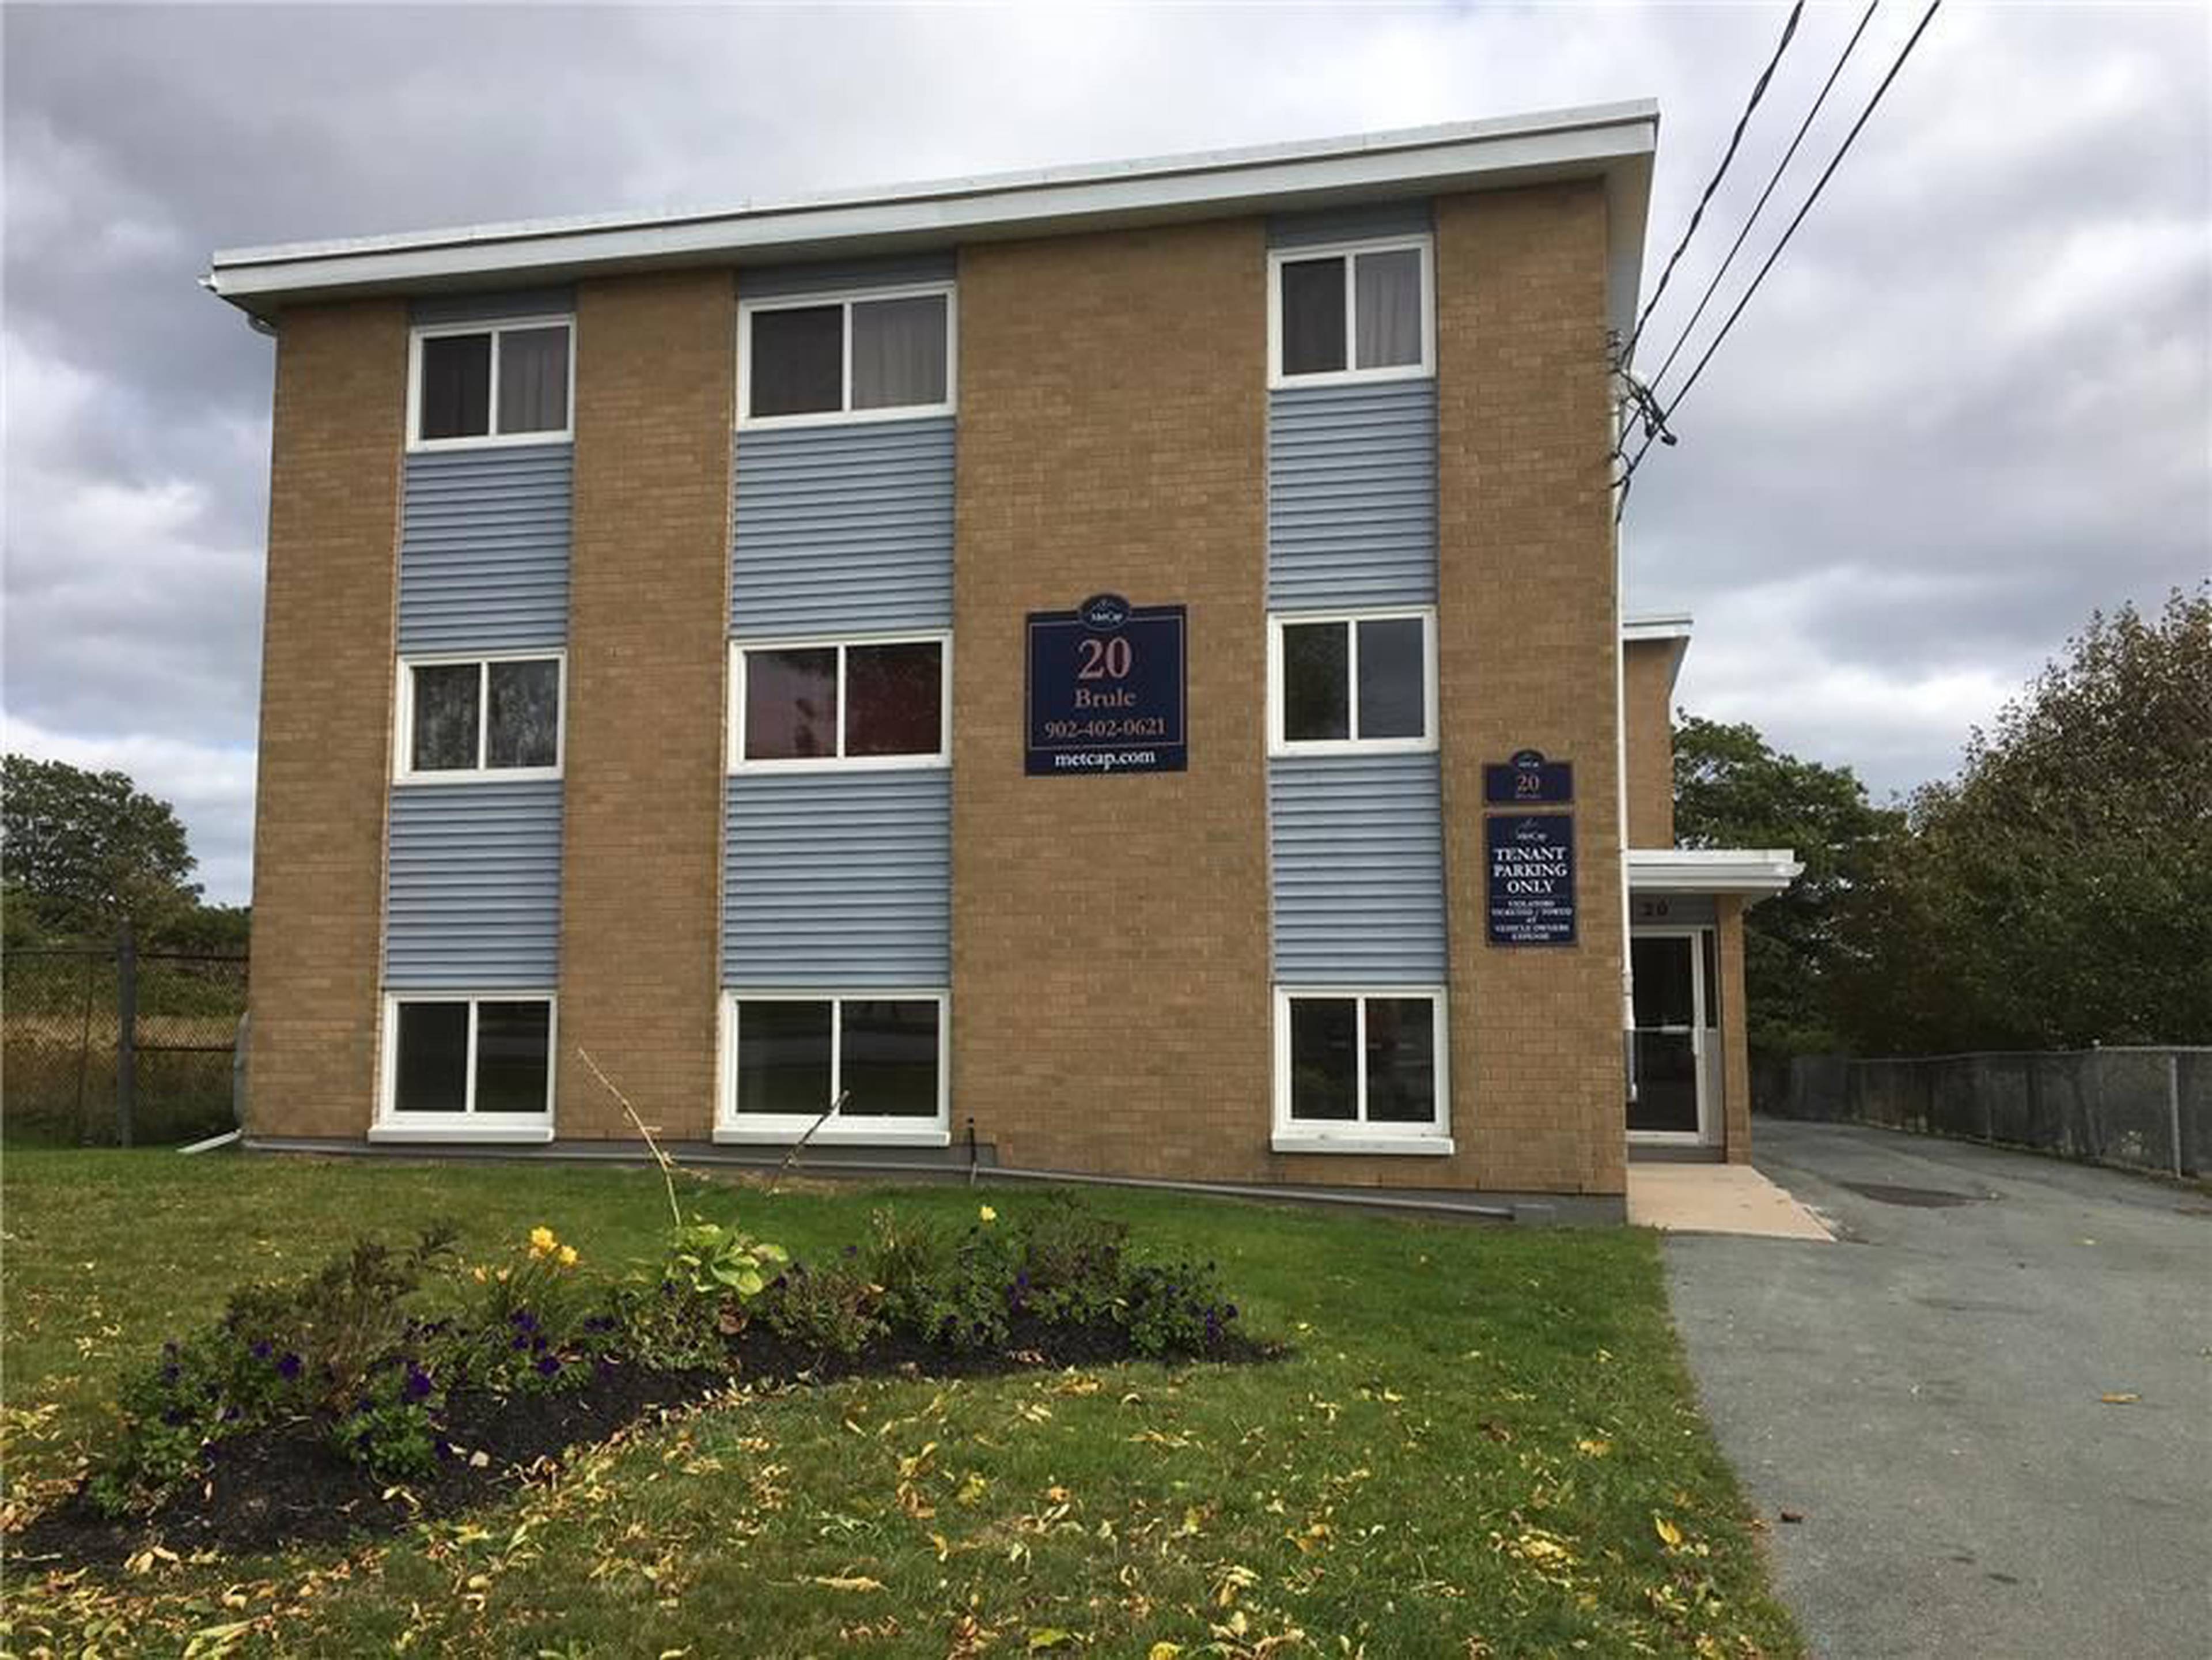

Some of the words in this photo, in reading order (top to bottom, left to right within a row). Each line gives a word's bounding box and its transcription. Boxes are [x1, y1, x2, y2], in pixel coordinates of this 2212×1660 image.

[1078, 636, 1132, 679] 20
[1074, 689, 1136, 708] Brule
[1044, 718, 1166, 739] 902-402-0621
[1055, 751, 1156, 770] metcap.com
[1517, 774, 1540, 792] 20
[1493, 846, 1566, 861] TENANT
[1493, 863, 1568, 877] PARKING
[1507, 879, 1555, 893] ONLY
[1643, 901, 1669, 916] 20
